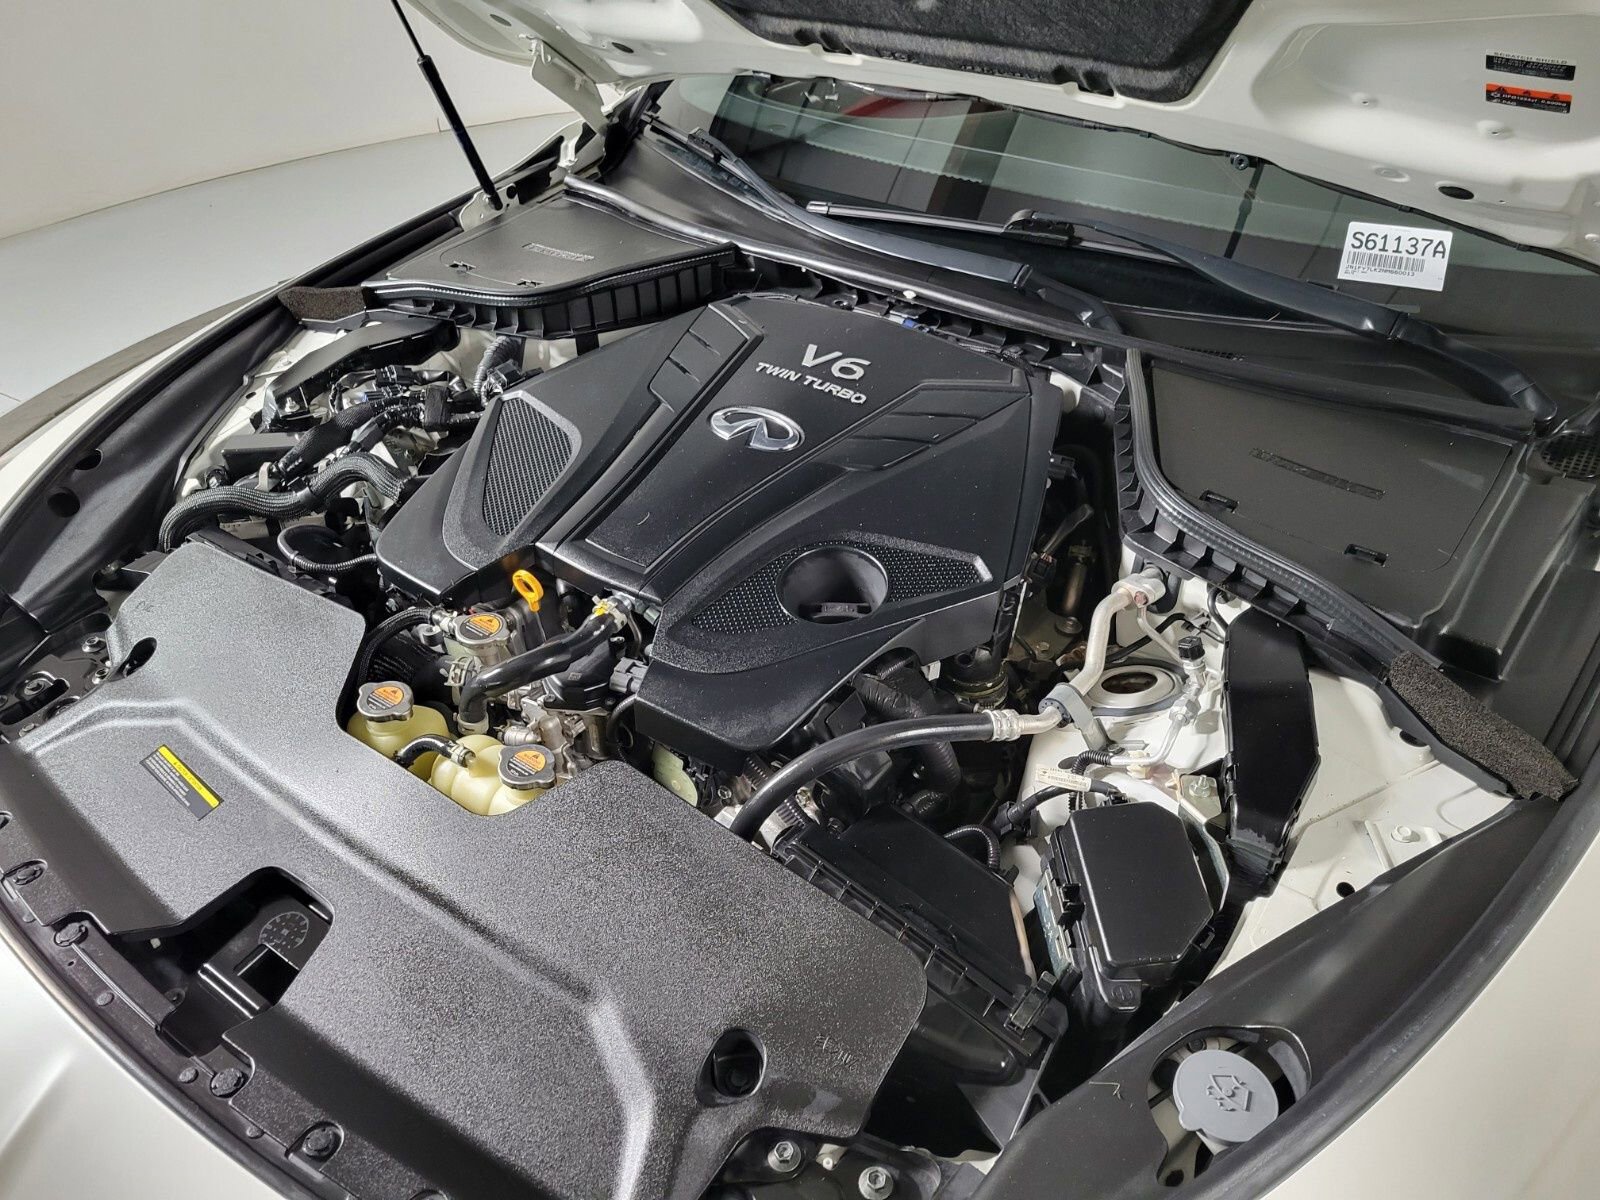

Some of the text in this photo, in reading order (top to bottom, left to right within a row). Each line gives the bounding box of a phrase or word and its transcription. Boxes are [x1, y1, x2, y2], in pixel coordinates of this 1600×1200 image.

[1350, 231, 1447, 259] S61137A
[802, 343, 871, 381] V6
[755, 362, 867, 404] TWIN TURBO
